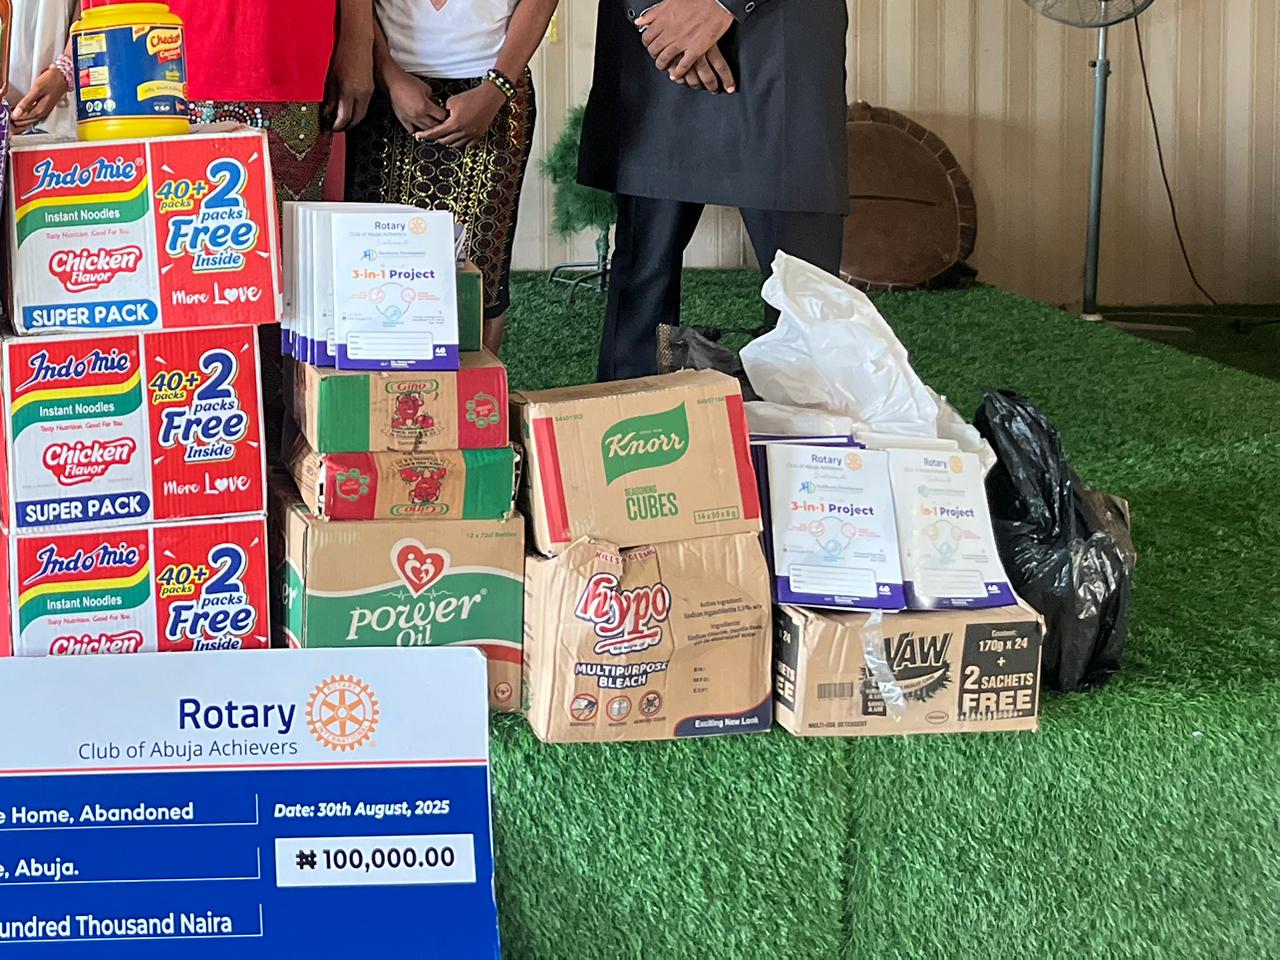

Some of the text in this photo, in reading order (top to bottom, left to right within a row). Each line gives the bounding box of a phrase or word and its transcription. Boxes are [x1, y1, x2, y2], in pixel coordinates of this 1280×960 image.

[21, 157, 136, 200] Indomie
[157, 161, 243, 209] 40+ 2
[45, 208, 120, 222] Instant Noodles
[160, 198, 192, 211] packs
[201, 208, 243, 224] packs
[375, 221, 406, 232] Rotary
[168, 219, 253, 252] Free
[51, 250, 136, 271] Chicken
[194, 252, 241, 268] Inside
[71, 271, 112, 283] Flavor
[352, 269, 435, 280] 3-in-1 Project
[171, 289, 209, 304] More
[32, 303, 150, 327] SUPER PACK
[16, 349, 130, 392] Indomie
[397, 383, 426, 391] Gino
[39, 401, 115, 417] Instant Noodles
[45, 442, 129, 465] Chicken
[606, 432, 685, 458] Knorr
[811, 454, 842, 466] Rotary
[25, 494, 142, 523] SUPER PACK
[626, 493, 679, 521] CUBES
[791, 501, 874, 516] 3-in-1 Project
[23, 543, 138, 585] Indomie
[595, 551, 619, 565] KILLS
[397, 625, 433, 646] Oil
[979, 638, 1028, 652] 170g x 24
[575, 662, 668, 677] MULTIPURPOSE
[997, 656, 1006, 667] +
[599, 675, 646, 688] BLEACH
[964, 665, 1034, 689] 2 SACHETS
[962, 689, 1032, 712] FREE
[179, 698, 296, 734] Rotary
[695, 716, 759, 729] Exciting New Look
[79, 739, 298, 761] Club of Abuja Achievers
[12, 806, 75, 824] Home,
[80, 802, 194, 821] Abandoned
[274, 800, 450, 818] Date: 30th August, 2025
[15, 857, 79, 881] Abuja.
[323, 846, 455, 873] 100,000.00
[76, 913, 175, 935] Thousand
[180, 910, 233, 934] Naira
